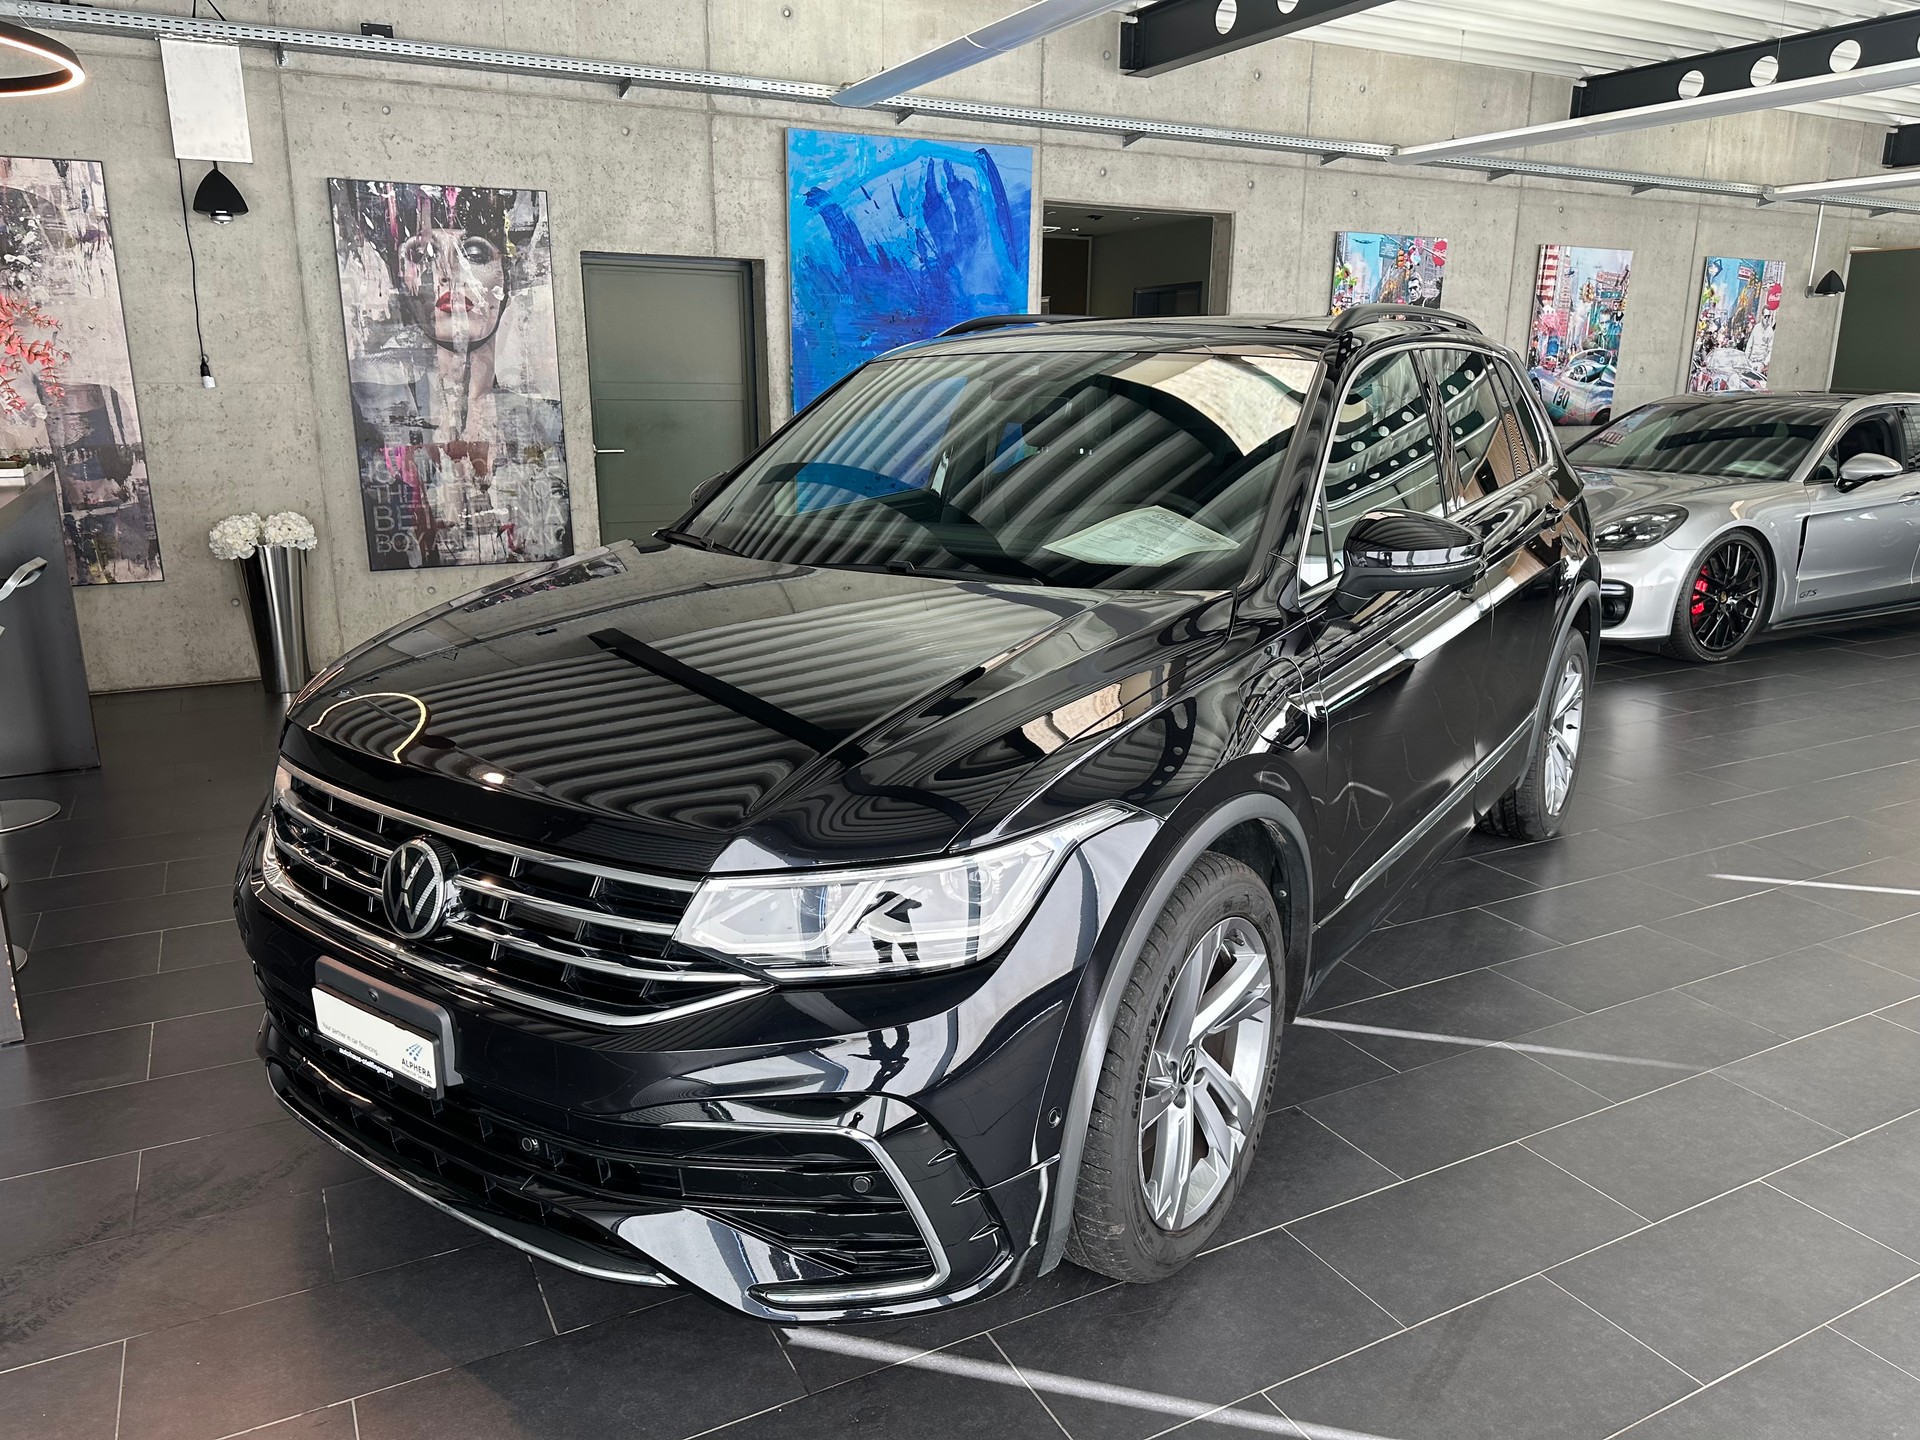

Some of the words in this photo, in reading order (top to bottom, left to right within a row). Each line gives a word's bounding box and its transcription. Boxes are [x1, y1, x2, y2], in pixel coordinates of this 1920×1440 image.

[1553, 386, 1570, 409] 130
[376, 531, 426, 553] BOY
[1799, 589, 1818, 599] GTS
[401, 1057, 432, 1079] ALPHERA
